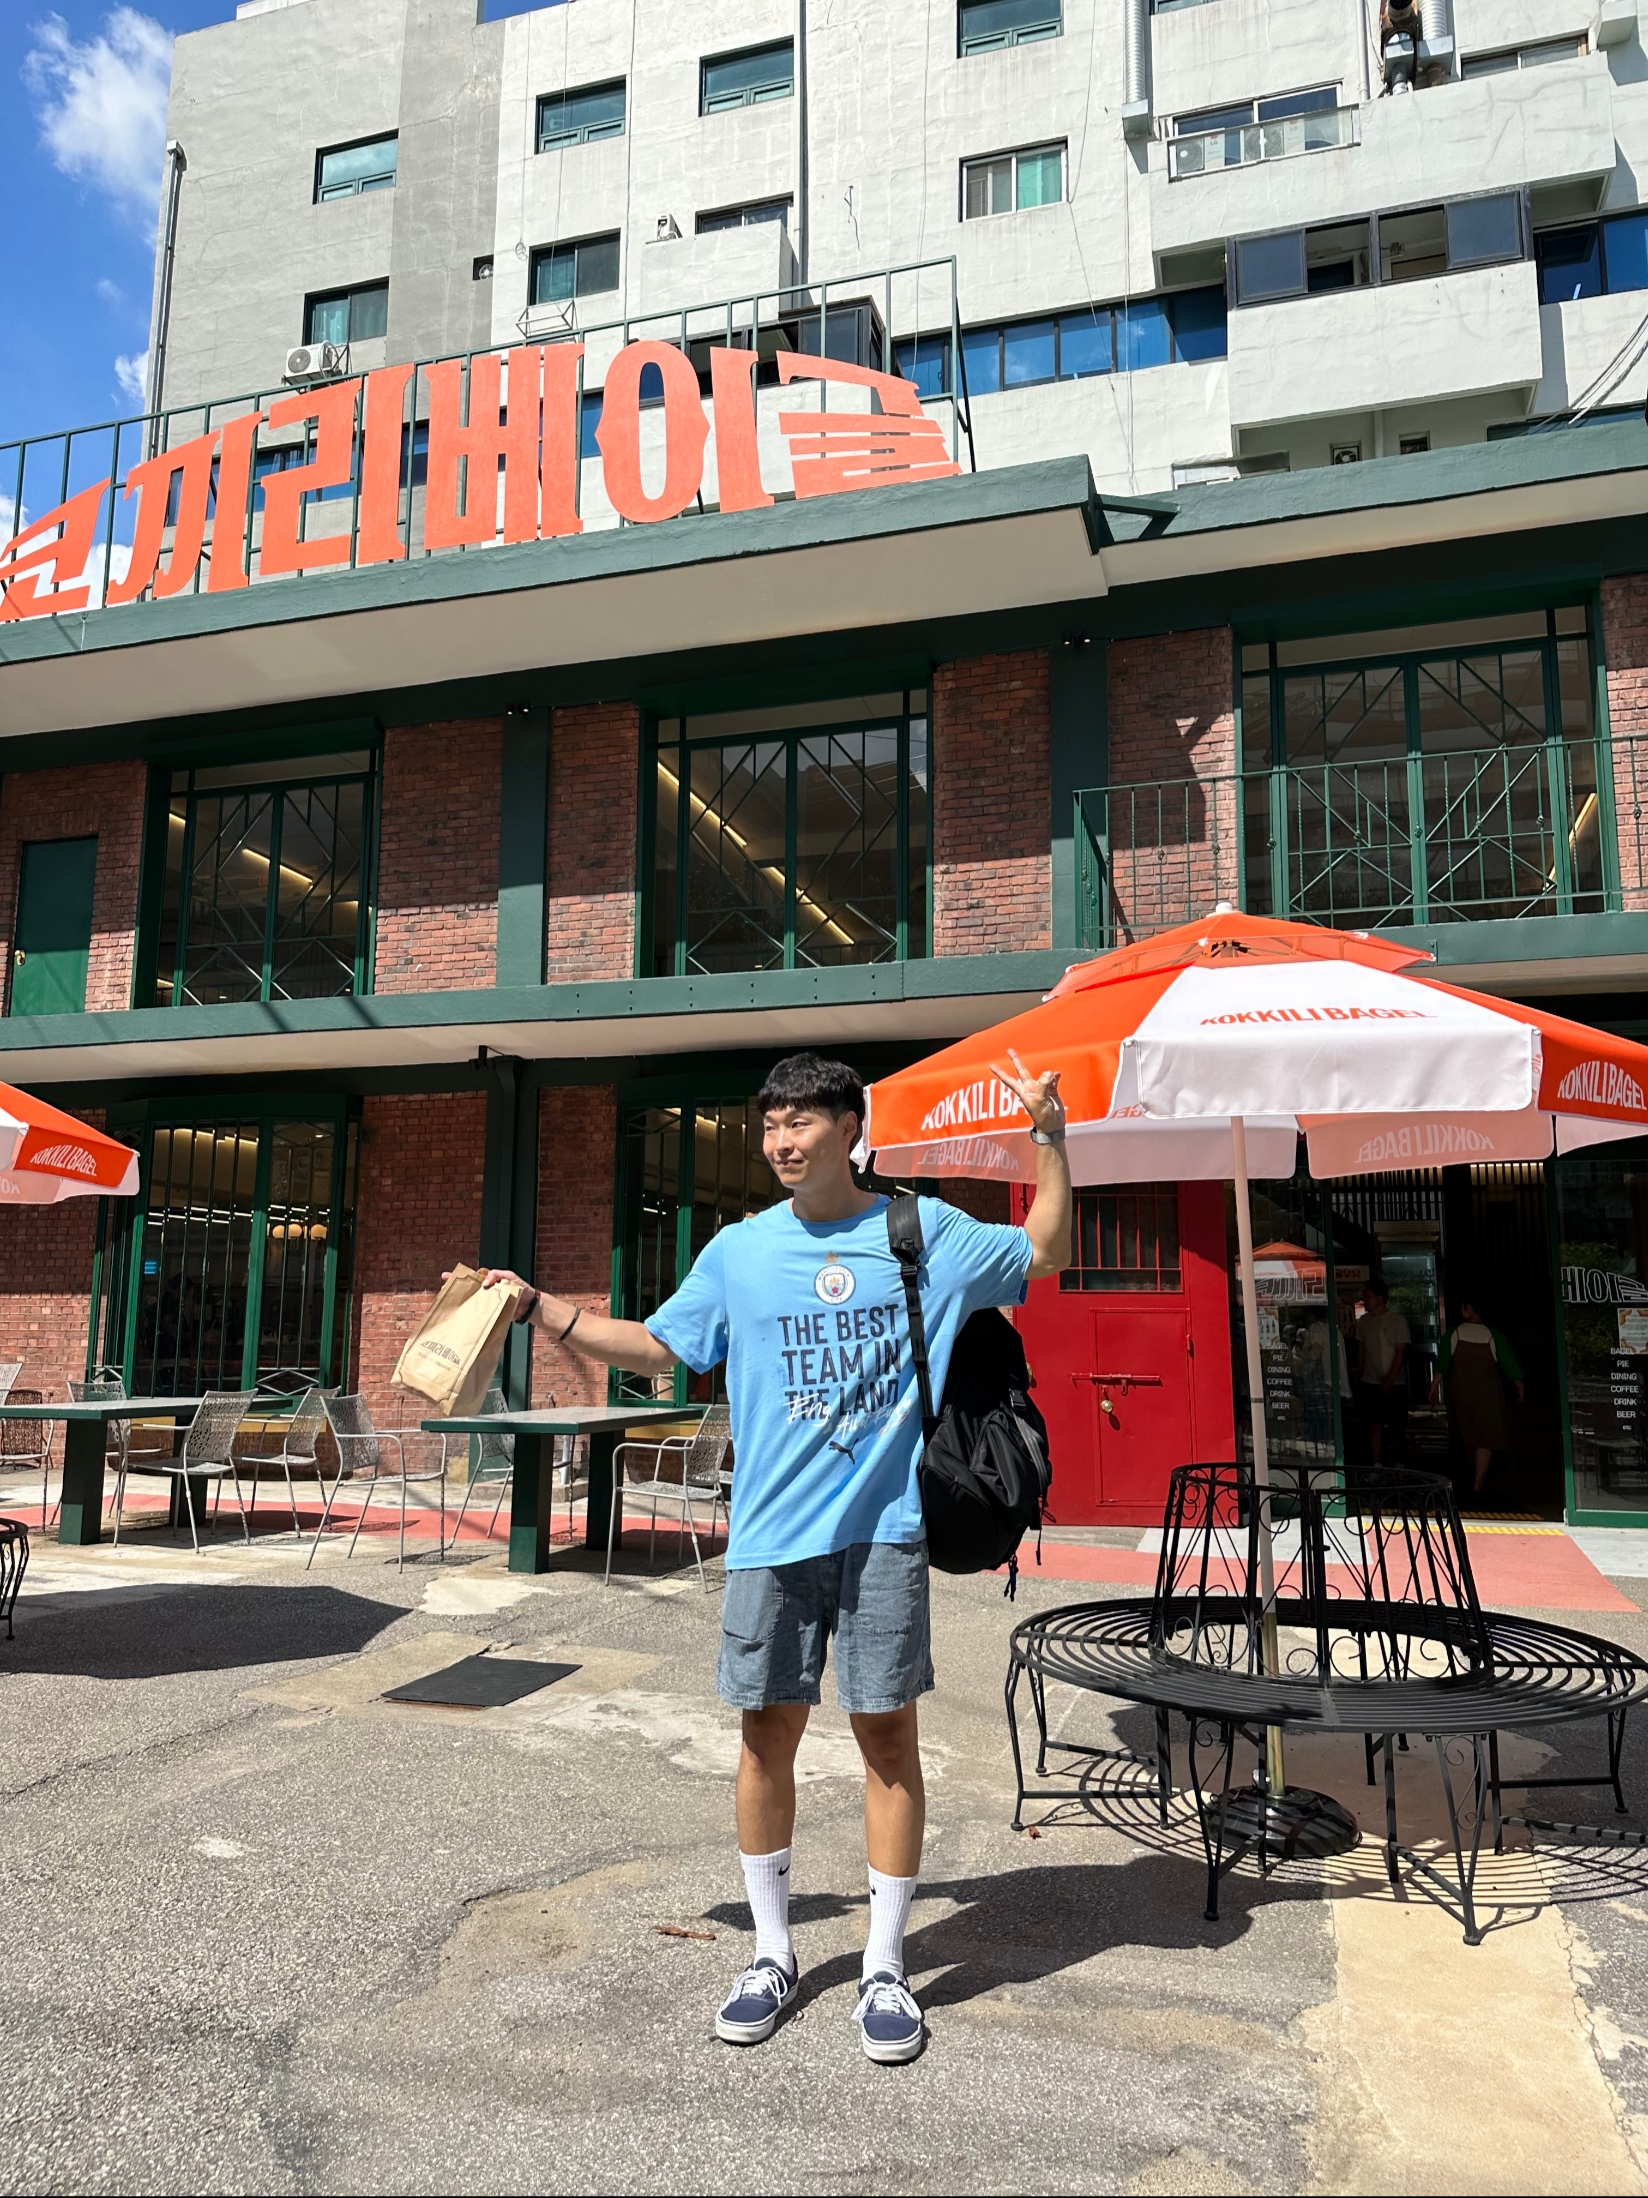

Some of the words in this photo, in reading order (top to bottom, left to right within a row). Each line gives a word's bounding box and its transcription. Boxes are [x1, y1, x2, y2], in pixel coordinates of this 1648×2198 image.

[0, 339, 961, 622] 코끼리베이글
[1200, 1008, 1324, 1025] KOKKILI
[1320, 1007, 1439, 1020] BAGEL
[1557, 1060, 1609, 1104] KOKKILI
[1607, 1062, 1648, 1111] BAGEL
[920, 1078, 997, 1131] KOKKILI
[30, 1144, 78, 1169] KOKKILI
[66, 1145, 98, 1177] BAGEL
[777, 1312, 828, 1346] THE
[836, 1303, 899, 1342] BEST
[782, 1343, 865, 1387] TEAM
[875, 1338, 902, 1376] IN
[1267, 1366, 1291, 1374] DINING
[1616, 1360, 1630, 1368] PIE
[1266, 1377, 1293, 1386] COFFEE
[1611, 1372, 1637, 1380] DINING
[784, 1388, 830, 1420] THE
[839, 1378, 899, 1416] LAND
[1611, 1385, 1639, 1393] COFFEE
[1613, 1397, 1637, 1406] DRINK
[782, 1393, 832, 1427] Eng
[1272, 1401, 1290, 1409] BEER
